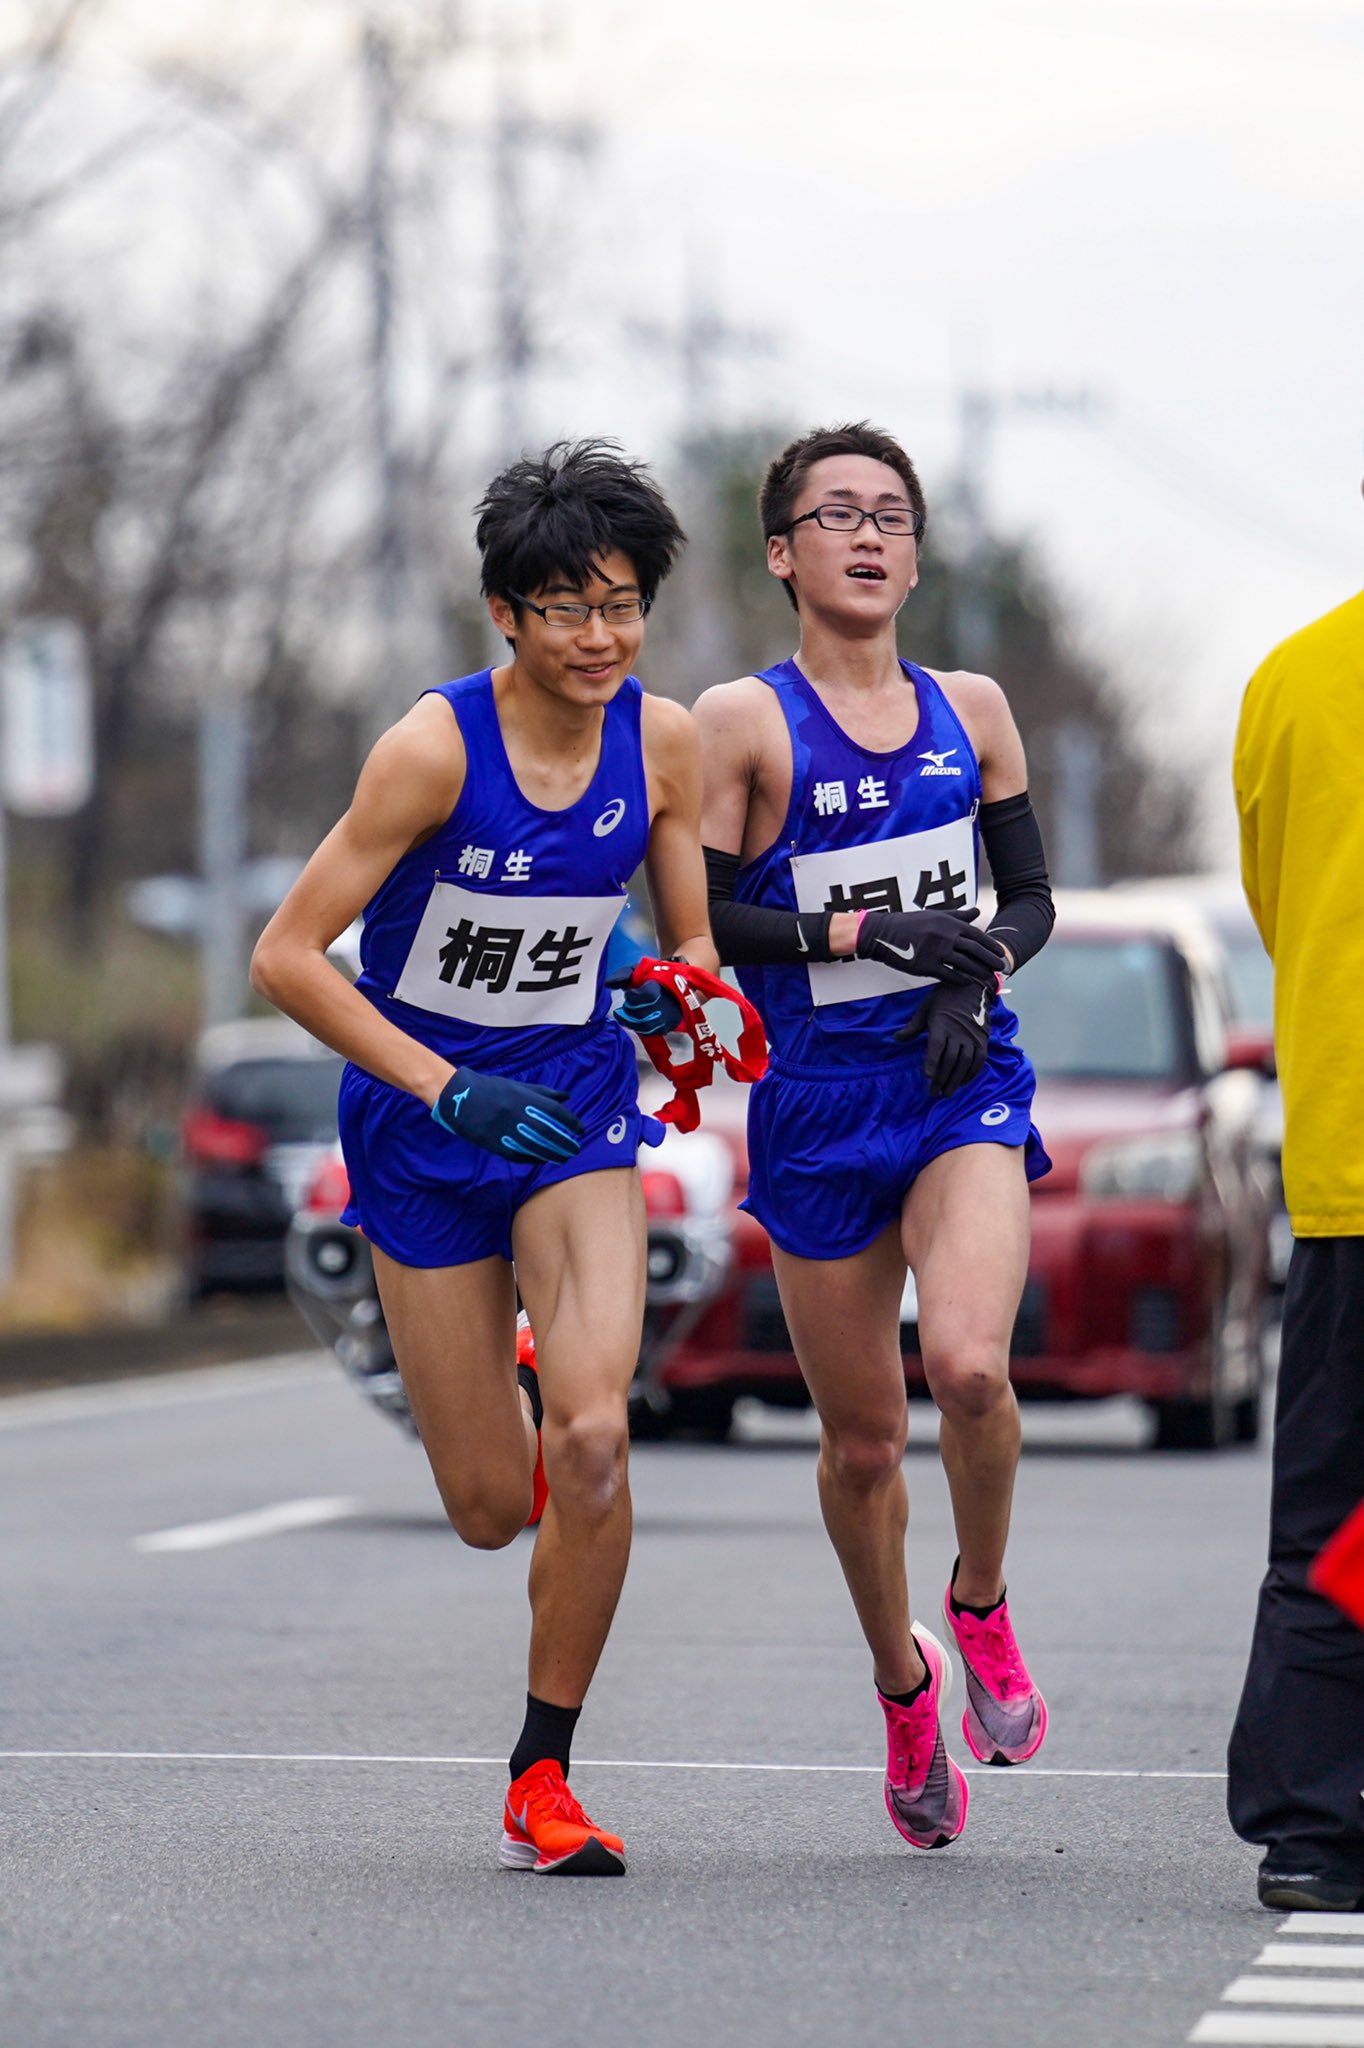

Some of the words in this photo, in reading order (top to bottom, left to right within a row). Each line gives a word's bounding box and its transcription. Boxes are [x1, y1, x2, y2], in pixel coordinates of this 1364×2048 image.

[812, 775, 890, 817] 桐生
[457, 844, 534, 882] 桐生
[438, 917, 594, 994] 桐生
